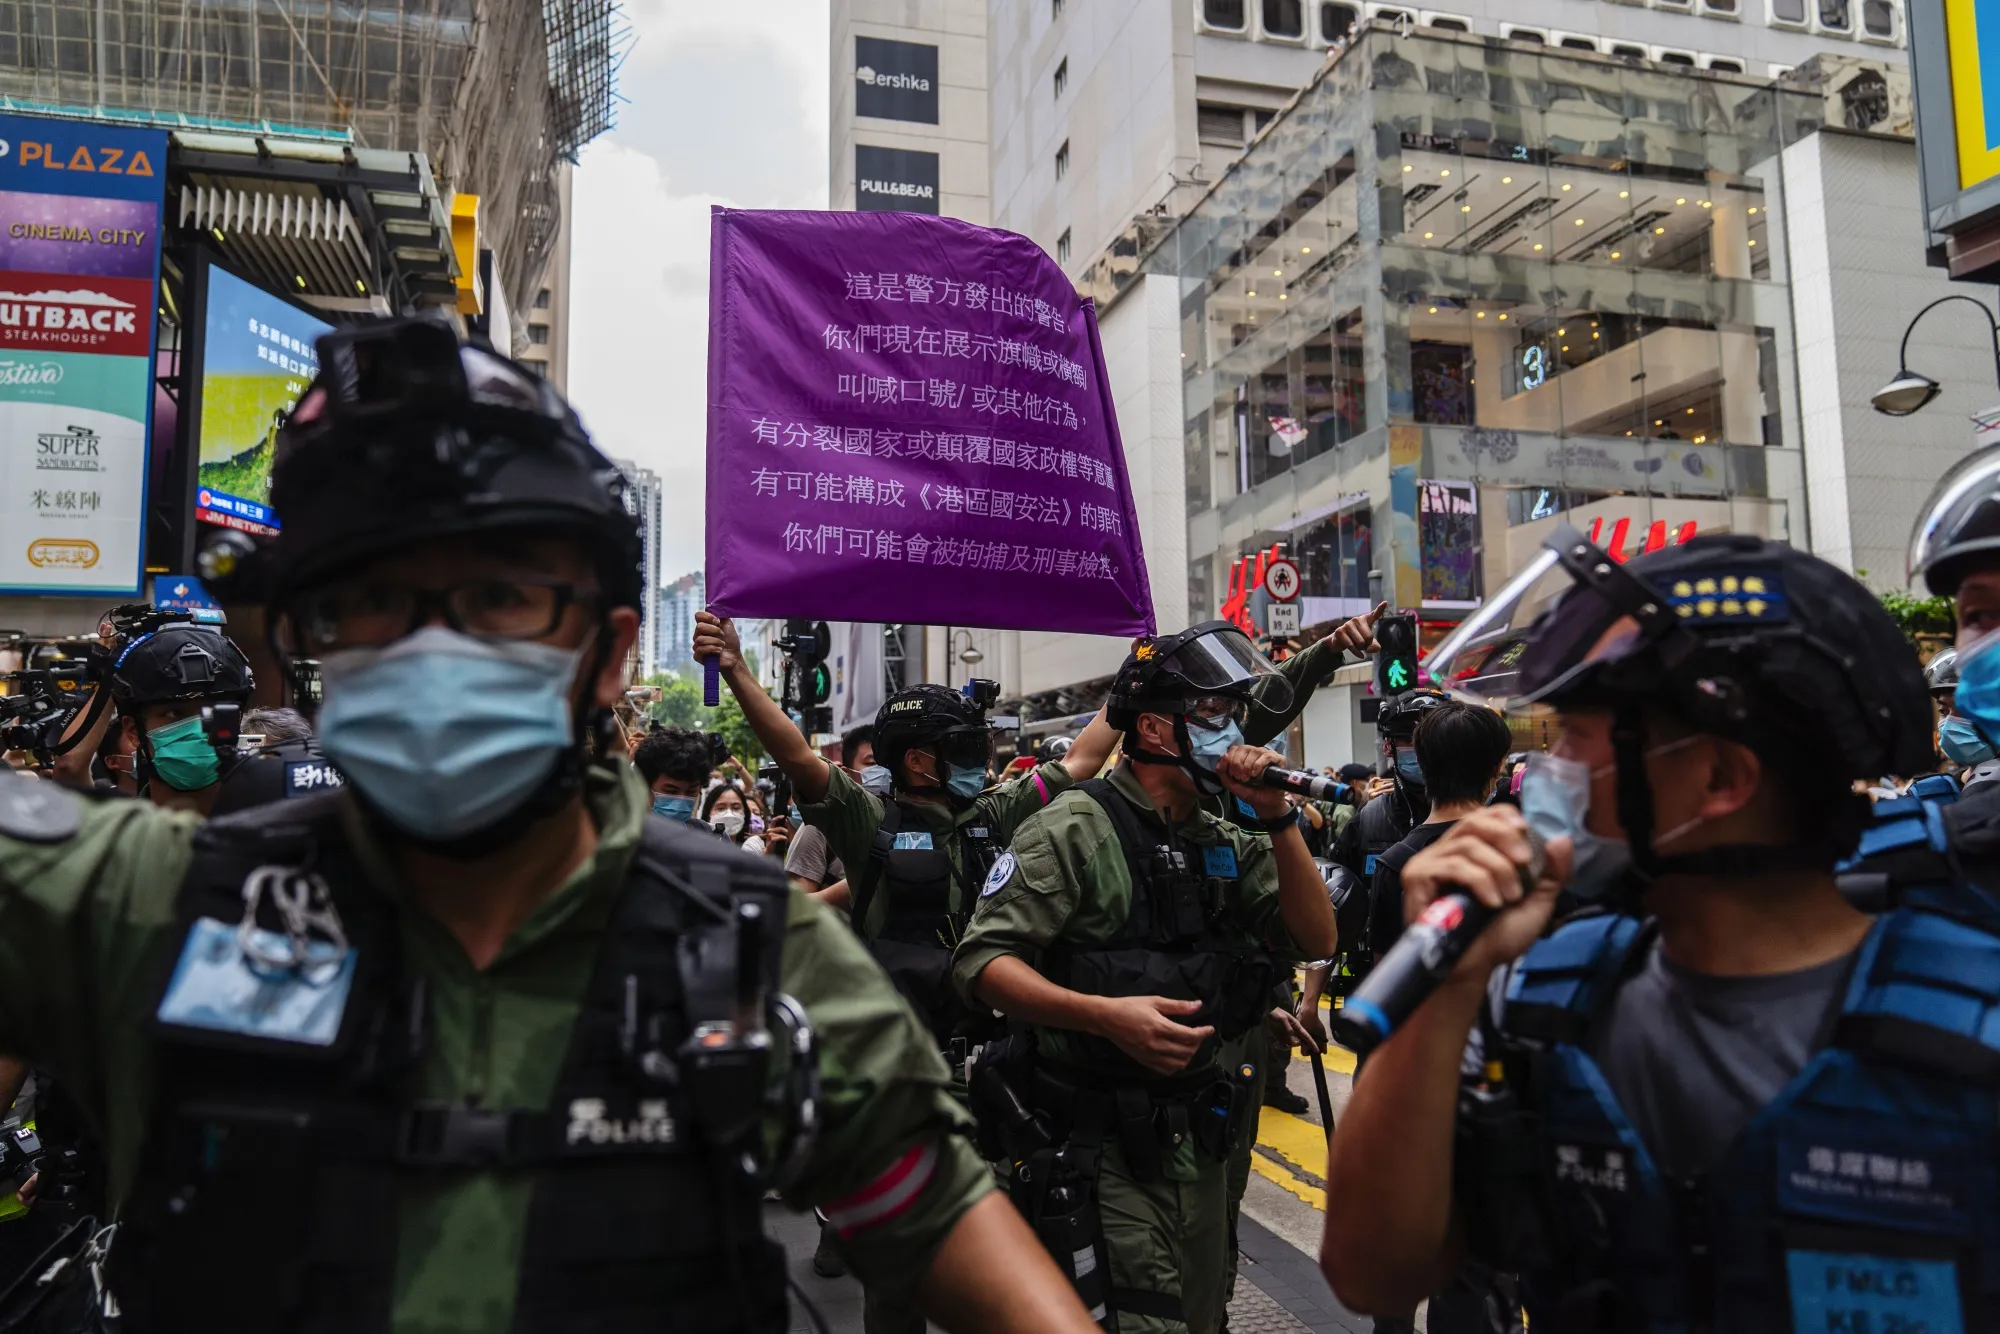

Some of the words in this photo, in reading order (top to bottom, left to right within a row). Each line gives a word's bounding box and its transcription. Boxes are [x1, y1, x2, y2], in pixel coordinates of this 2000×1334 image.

[19, 140, 154, 176] PLAZA
[860, 179, 933, 199] PULL&BEAR
[8, 222, 93, 243] CINEMA
[98, 227, 147, 247] CITY
[0, 303, 137, 334] UTBACK
[1523, 345, 1545, 390] 3
[36, 436, 99, 456] SUPER
[205, 511, 224, 525] JM
[1275, 607, 1292, 616] End
[1272, 620, 1295, 631] 終止
[890, 699, 923, 713] POLICE
[60, 707, 78, 728] SONY
[566, 1117, 676, 1145] POLICE
